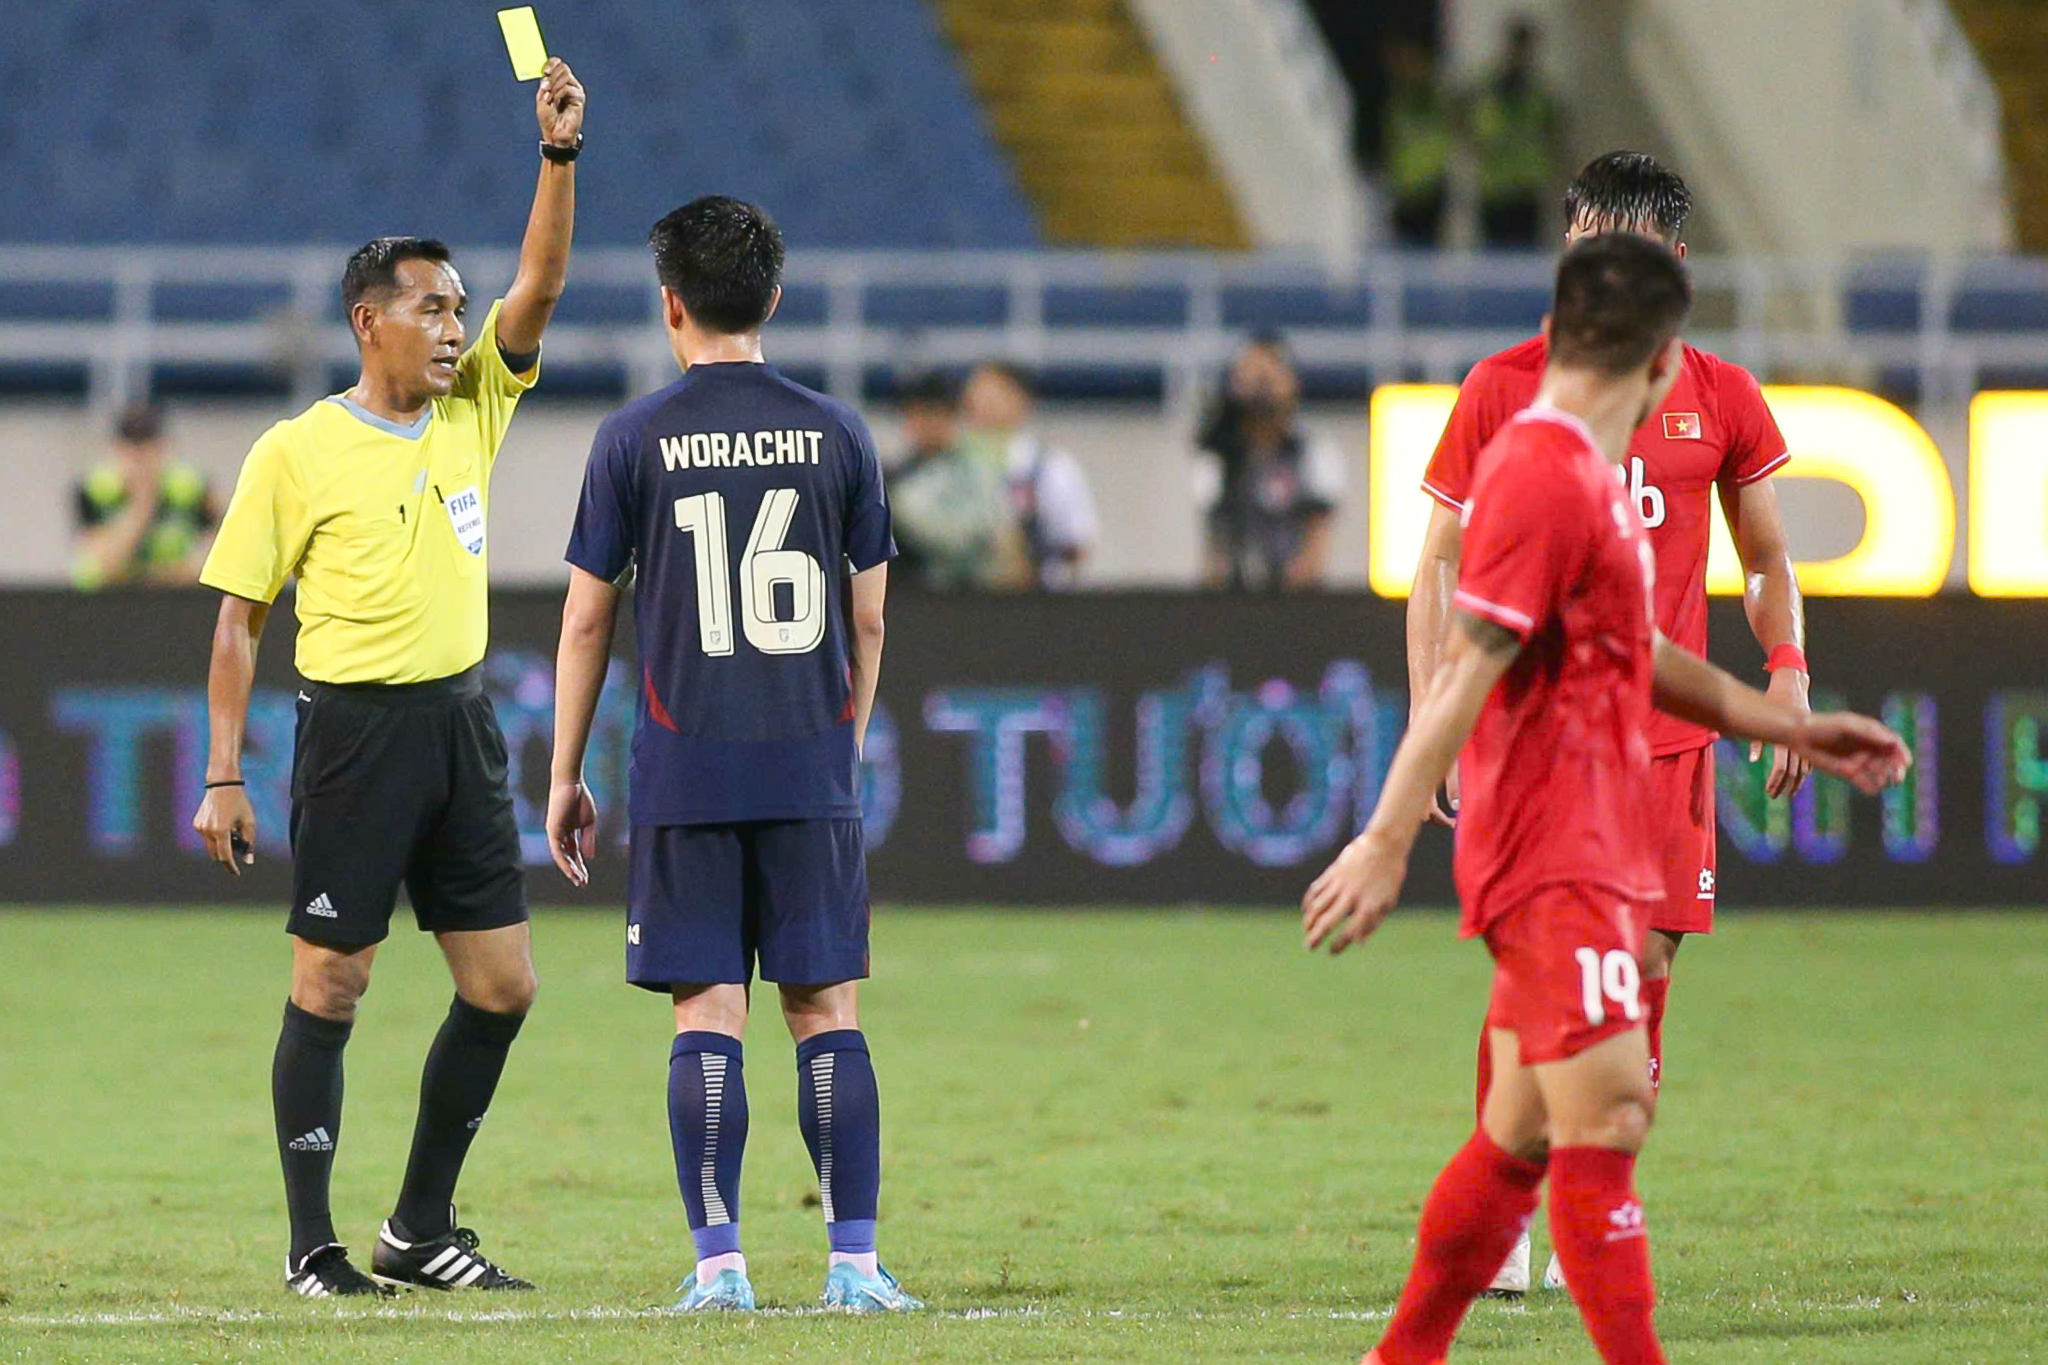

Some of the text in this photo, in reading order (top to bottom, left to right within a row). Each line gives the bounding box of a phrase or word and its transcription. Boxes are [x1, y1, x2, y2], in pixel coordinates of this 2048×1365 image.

[659, 429, 823, 472] WORACHIT
[450, 492, 477, 515] FIFA
[673, 488, 826, 657] 16
[306, 906, 338, 918] adidas
[1575, 946, 1640, 1026] 19
[289, 1139, 334, 1151] adidas
